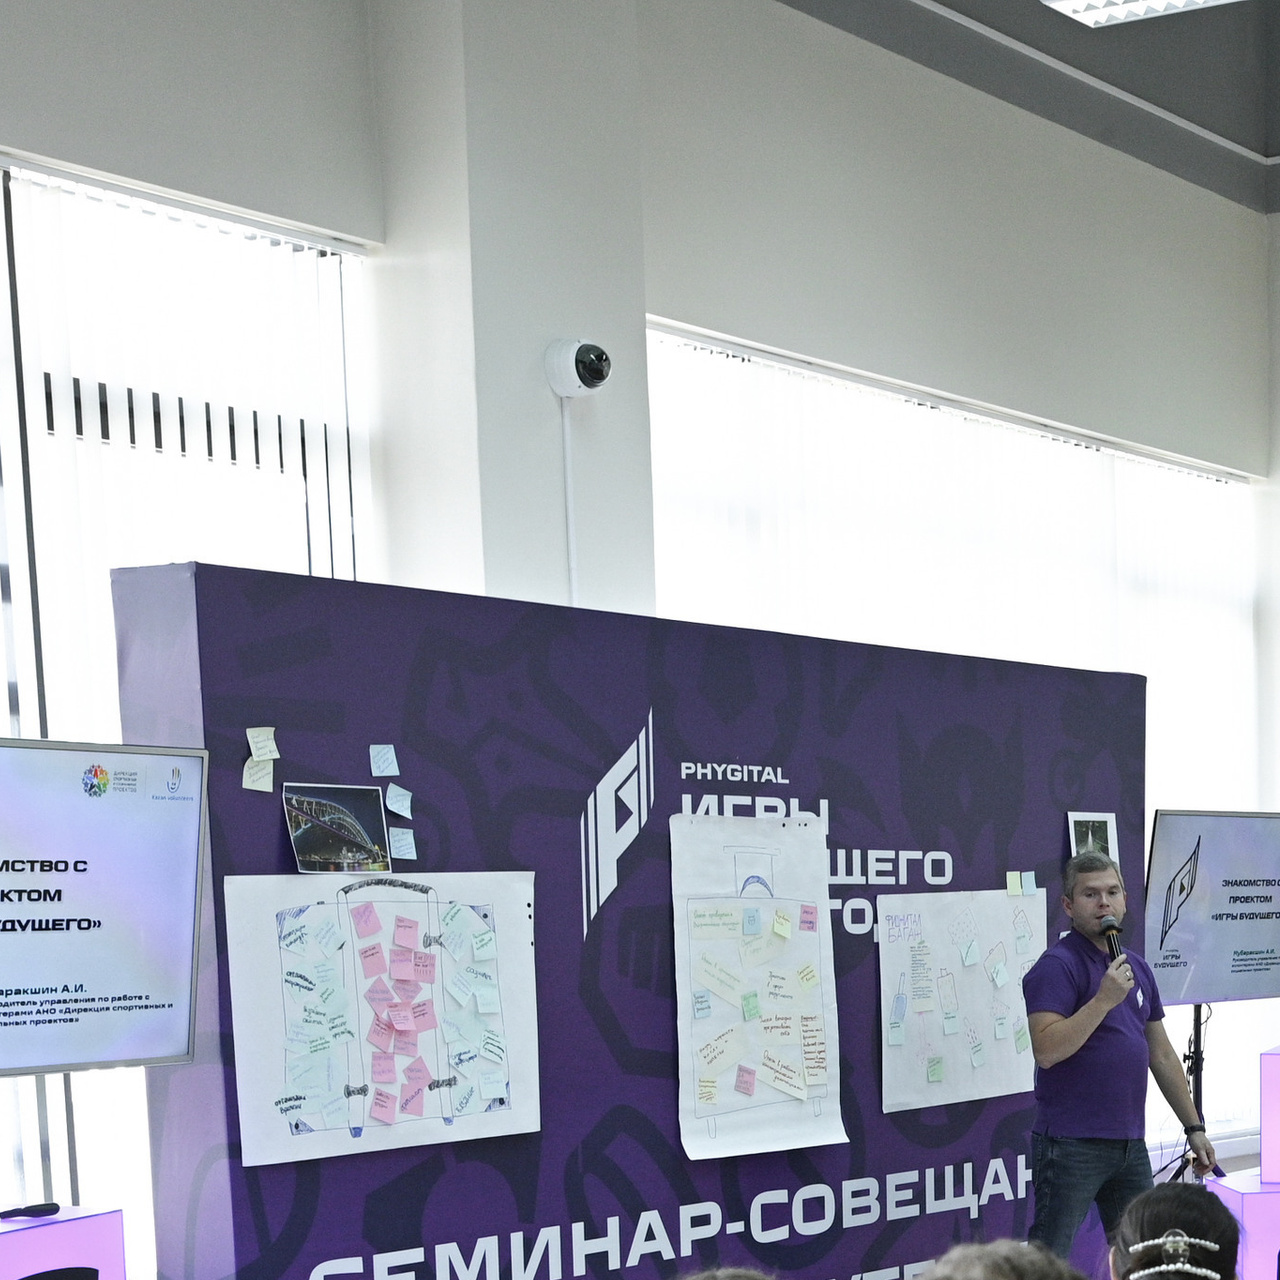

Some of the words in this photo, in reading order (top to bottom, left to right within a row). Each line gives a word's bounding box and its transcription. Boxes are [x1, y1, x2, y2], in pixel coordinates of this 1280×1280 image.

[681, 762, 790, 784] PHYGITAL
[73, 860, 88, 873] С
[828, 849, 953, 885] ЩЕГО
[1222, 879, 1276, 887] ЗНАКОМСТВО
[0, 889, 62, 902] КТОМ
[1229, 895, 1272, 904] ПРОЕКТОМ
[1211, 912, 1238, 920] «ИГРЫ
[0, 918, 102, 931] ДУЩЕГО»
[1153, 961, 1188, 969] БУДУЩЕГО
[0, 986, 58, 998] аракшин
[61, 983, 87, 994] А.И.
[39, 997, 96, 1007] управления
[111, 994, 143, 1003] работе
[35, 1007, 57, 1015] АНО
[58, 1005, 110, 1015] «Дирекция
[112, 1003, 166, 1012] спортивных
[29, 1017, 80, 1026] проектов»
